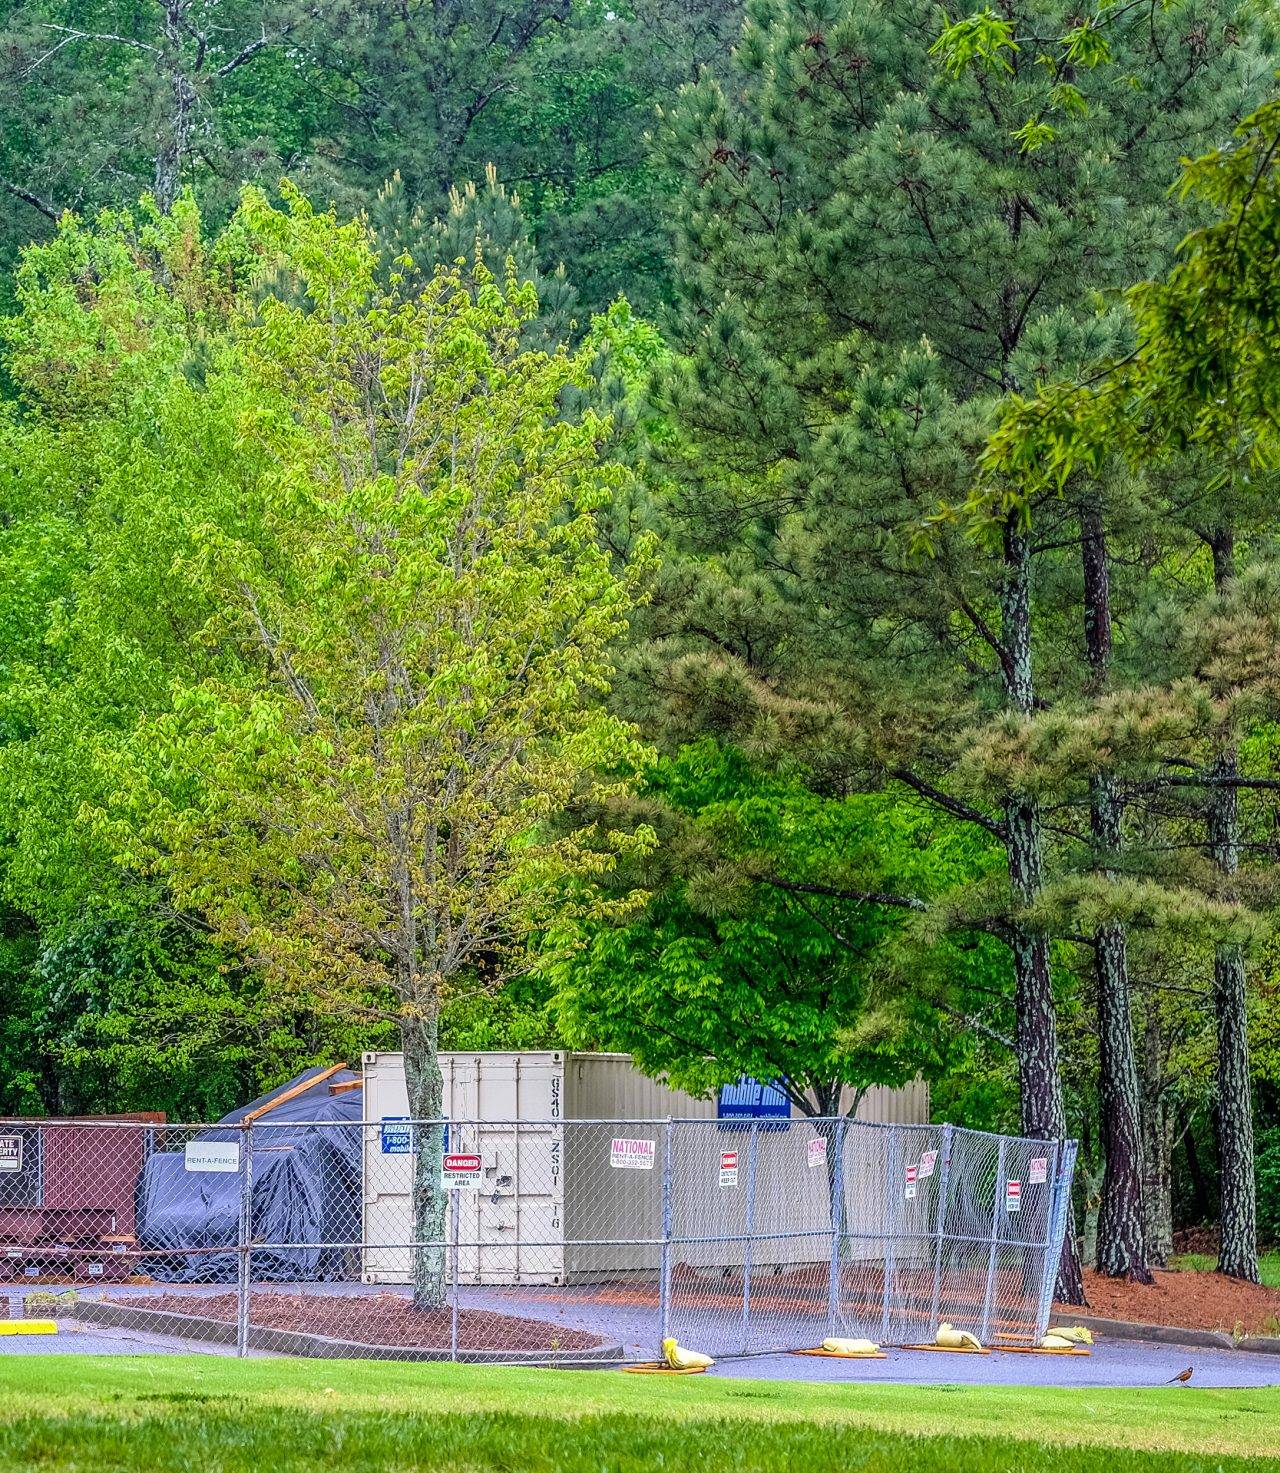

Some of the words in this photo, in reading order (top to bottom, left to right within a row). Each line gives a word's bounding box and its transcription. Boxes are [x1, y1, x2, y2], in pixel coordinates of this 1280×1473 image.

[721, 1073, 761, 1106] mobile
[612, 1140, 654, 1154] NATIONAL
[446, 1159, 478, 1167] DANGER
